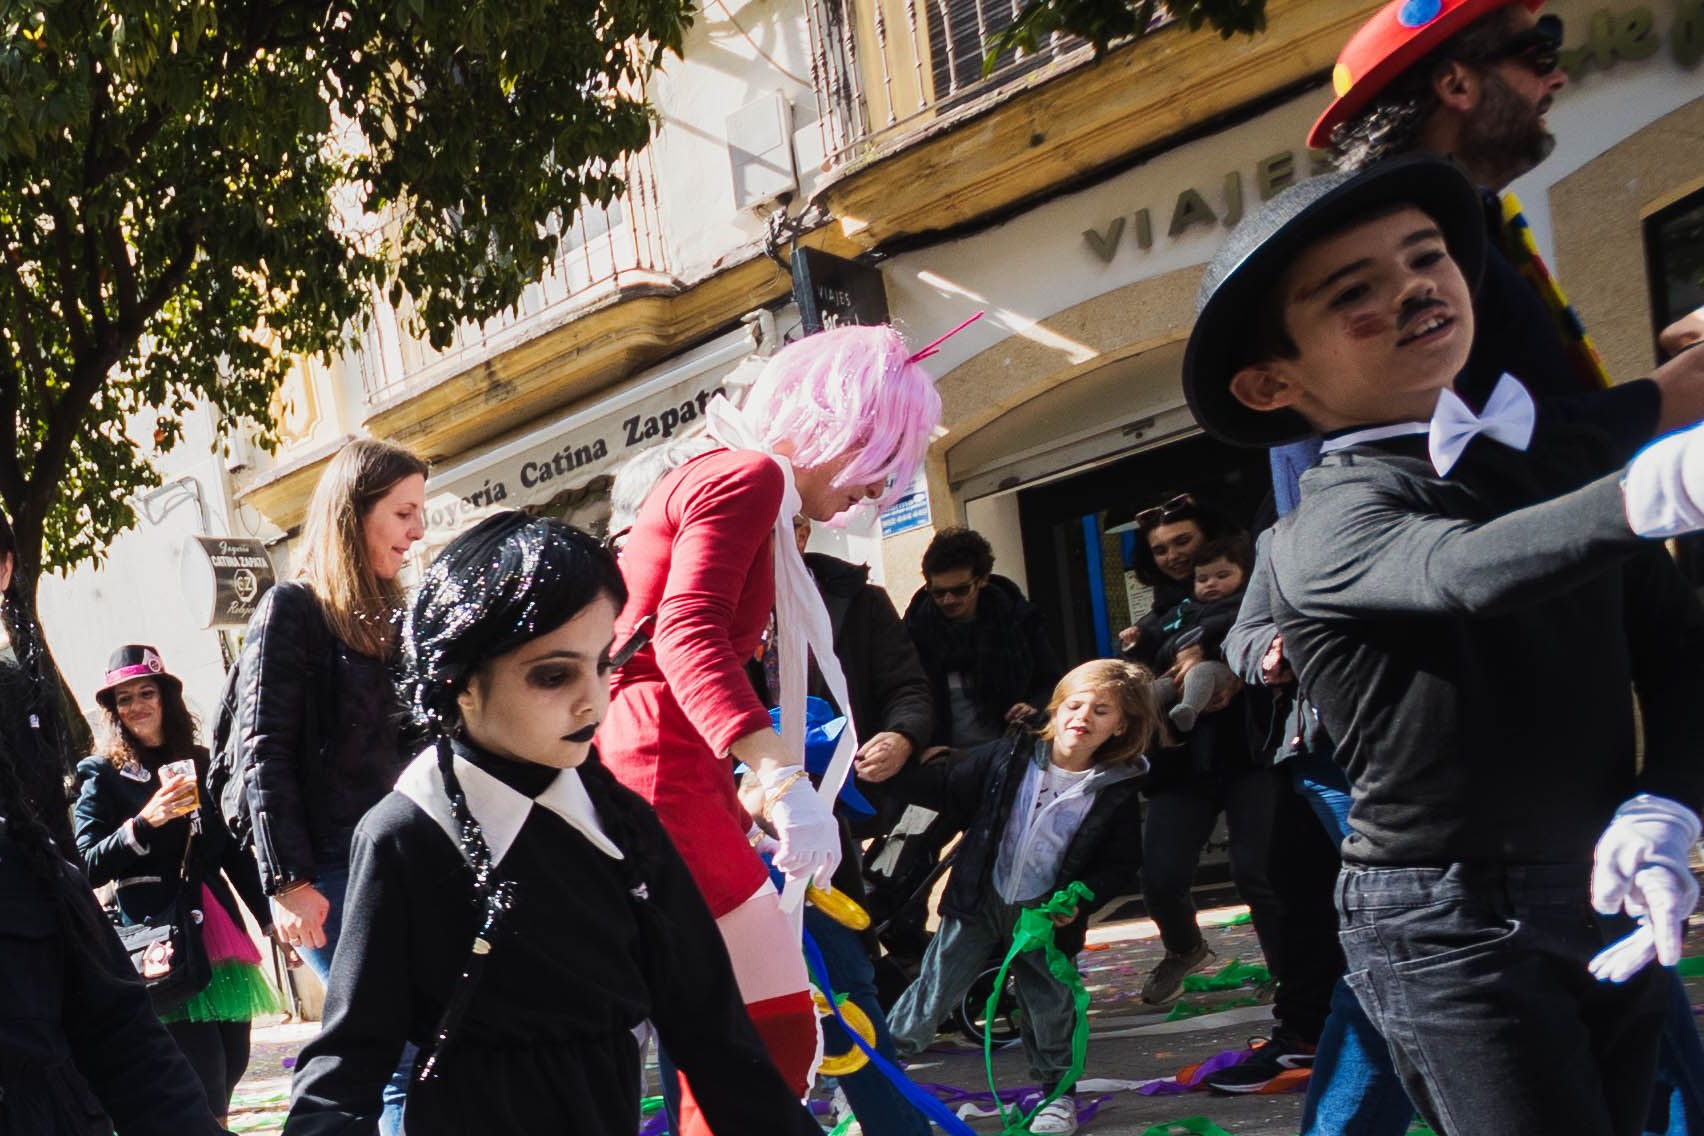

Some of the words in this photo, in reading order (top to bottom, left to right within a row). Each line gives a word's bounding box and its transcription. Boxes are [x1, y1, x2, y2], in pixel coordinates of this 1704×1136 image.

[818, 284, 852, 307] VIAJES
[520, 437, 608, 488] Catina
[210, 555, 240, 567] CATINA
[239, 556, 269, 568] ZAPATA
